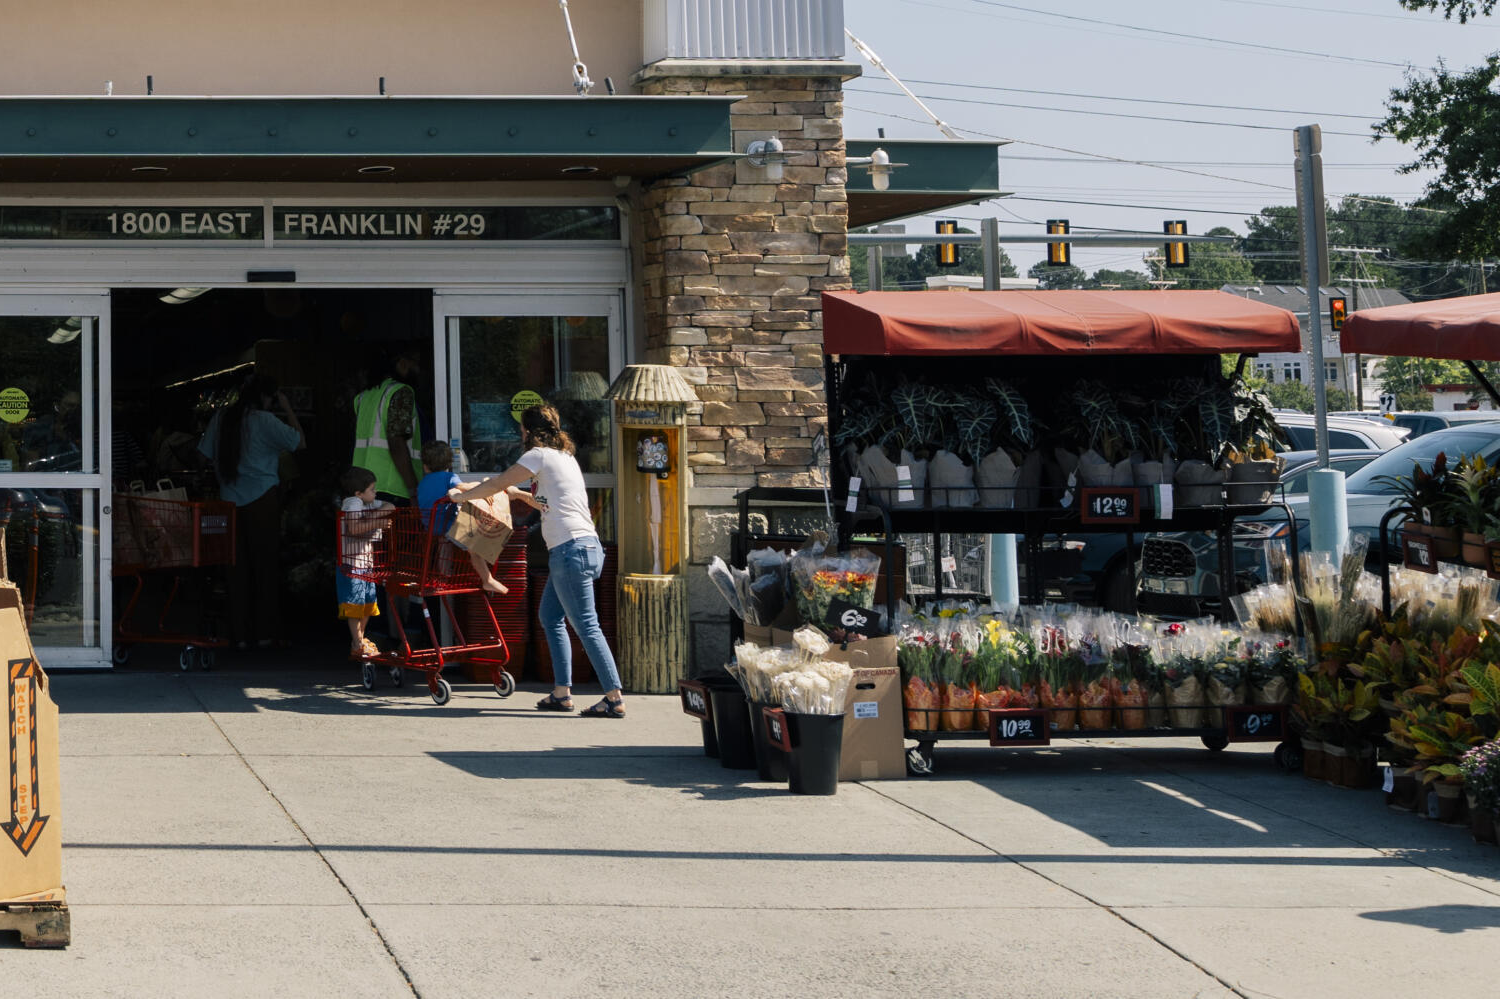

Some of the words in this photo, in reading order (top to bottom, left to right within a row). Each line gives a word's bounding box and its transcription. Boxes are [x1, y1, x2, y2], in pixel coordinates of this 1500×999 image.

[107, 212, 171, 234] 1800
[180, 212, 252, 234] EAST
[284, 213, 423, 235] FRANKLIN
[432, 214, 486, 236] #29
[871, 669, 897, 677] CANADA
[14, 683, 27, 736] WATCH
[18, 783, 30, 825] STEP
